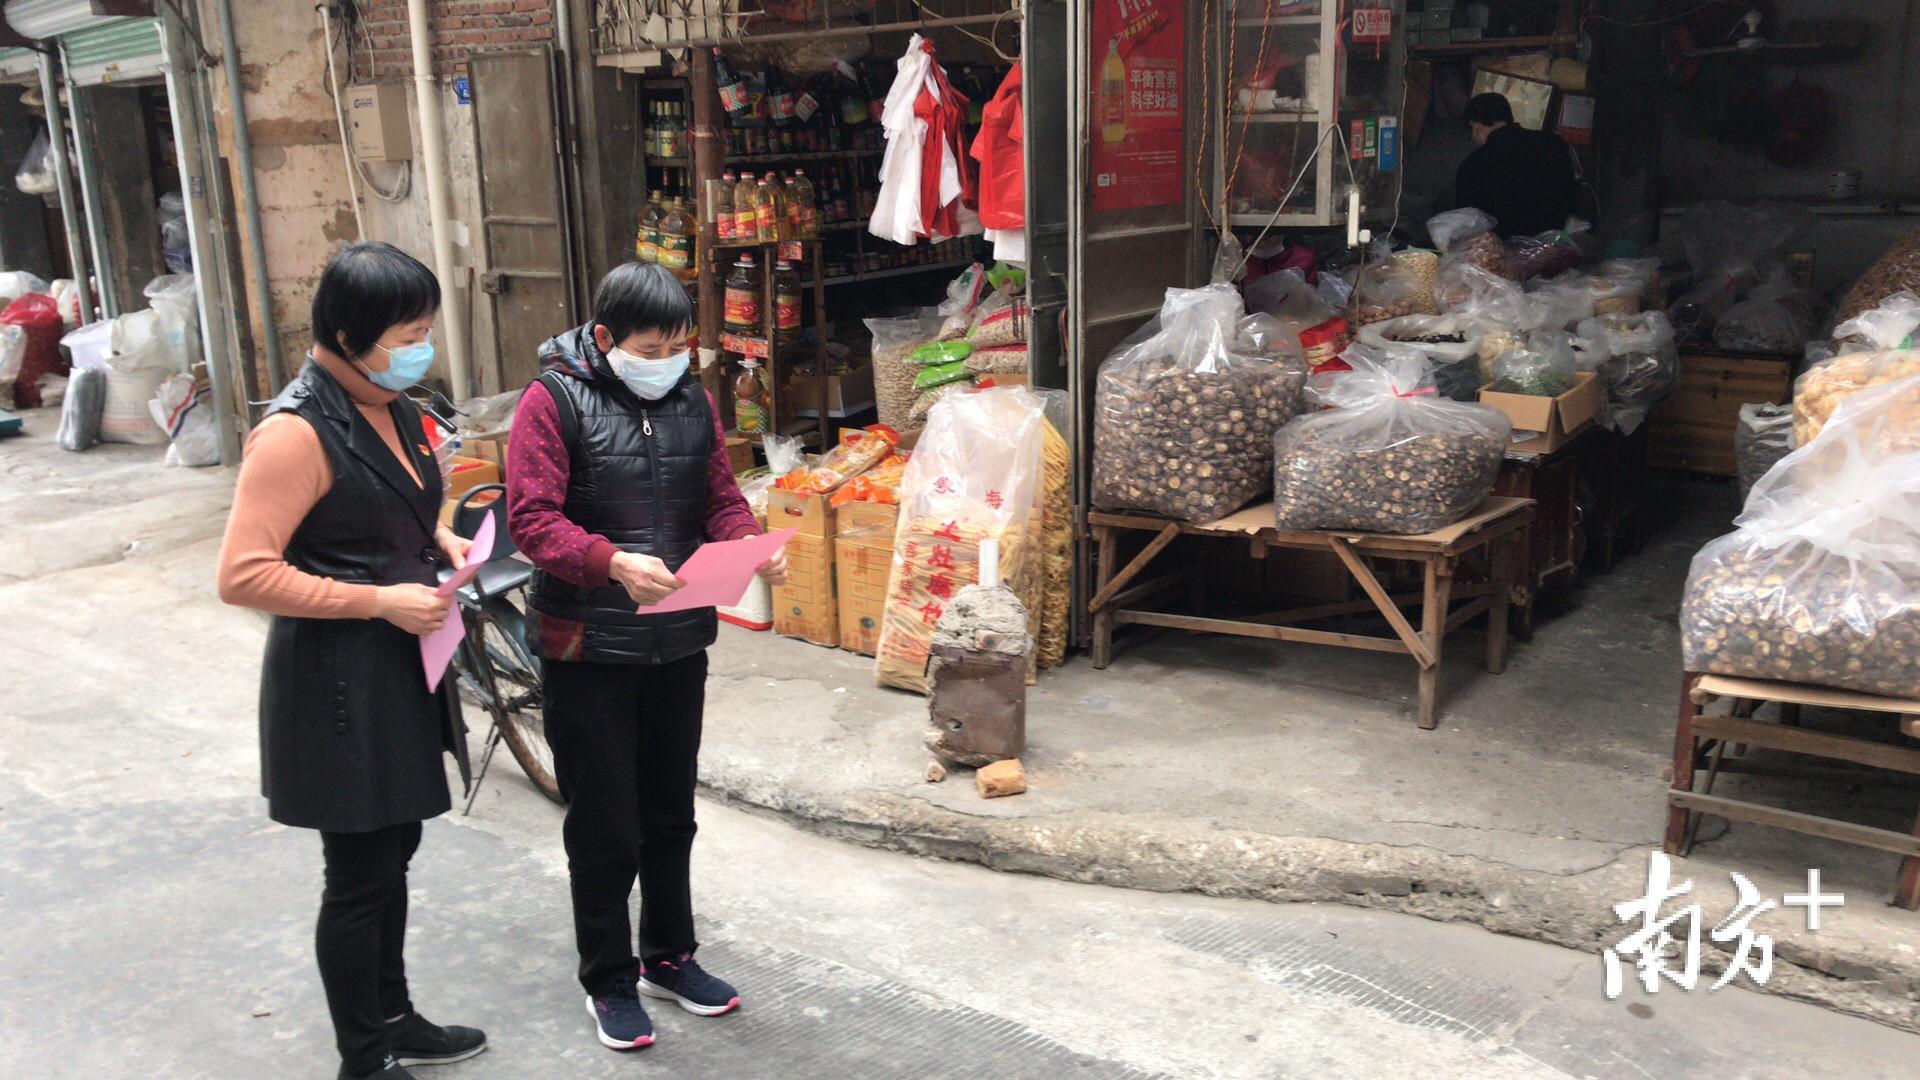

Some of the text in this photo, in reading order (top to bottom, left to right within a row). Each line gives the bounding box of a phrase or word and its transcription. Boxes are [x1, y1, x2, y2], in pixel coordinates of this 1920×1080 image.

[1130, 69, 1177, 89] 平衡营养
[1130, 90, 1178, 109] 科学好油
[918, 519, 961, 626] 土灶腐竹
